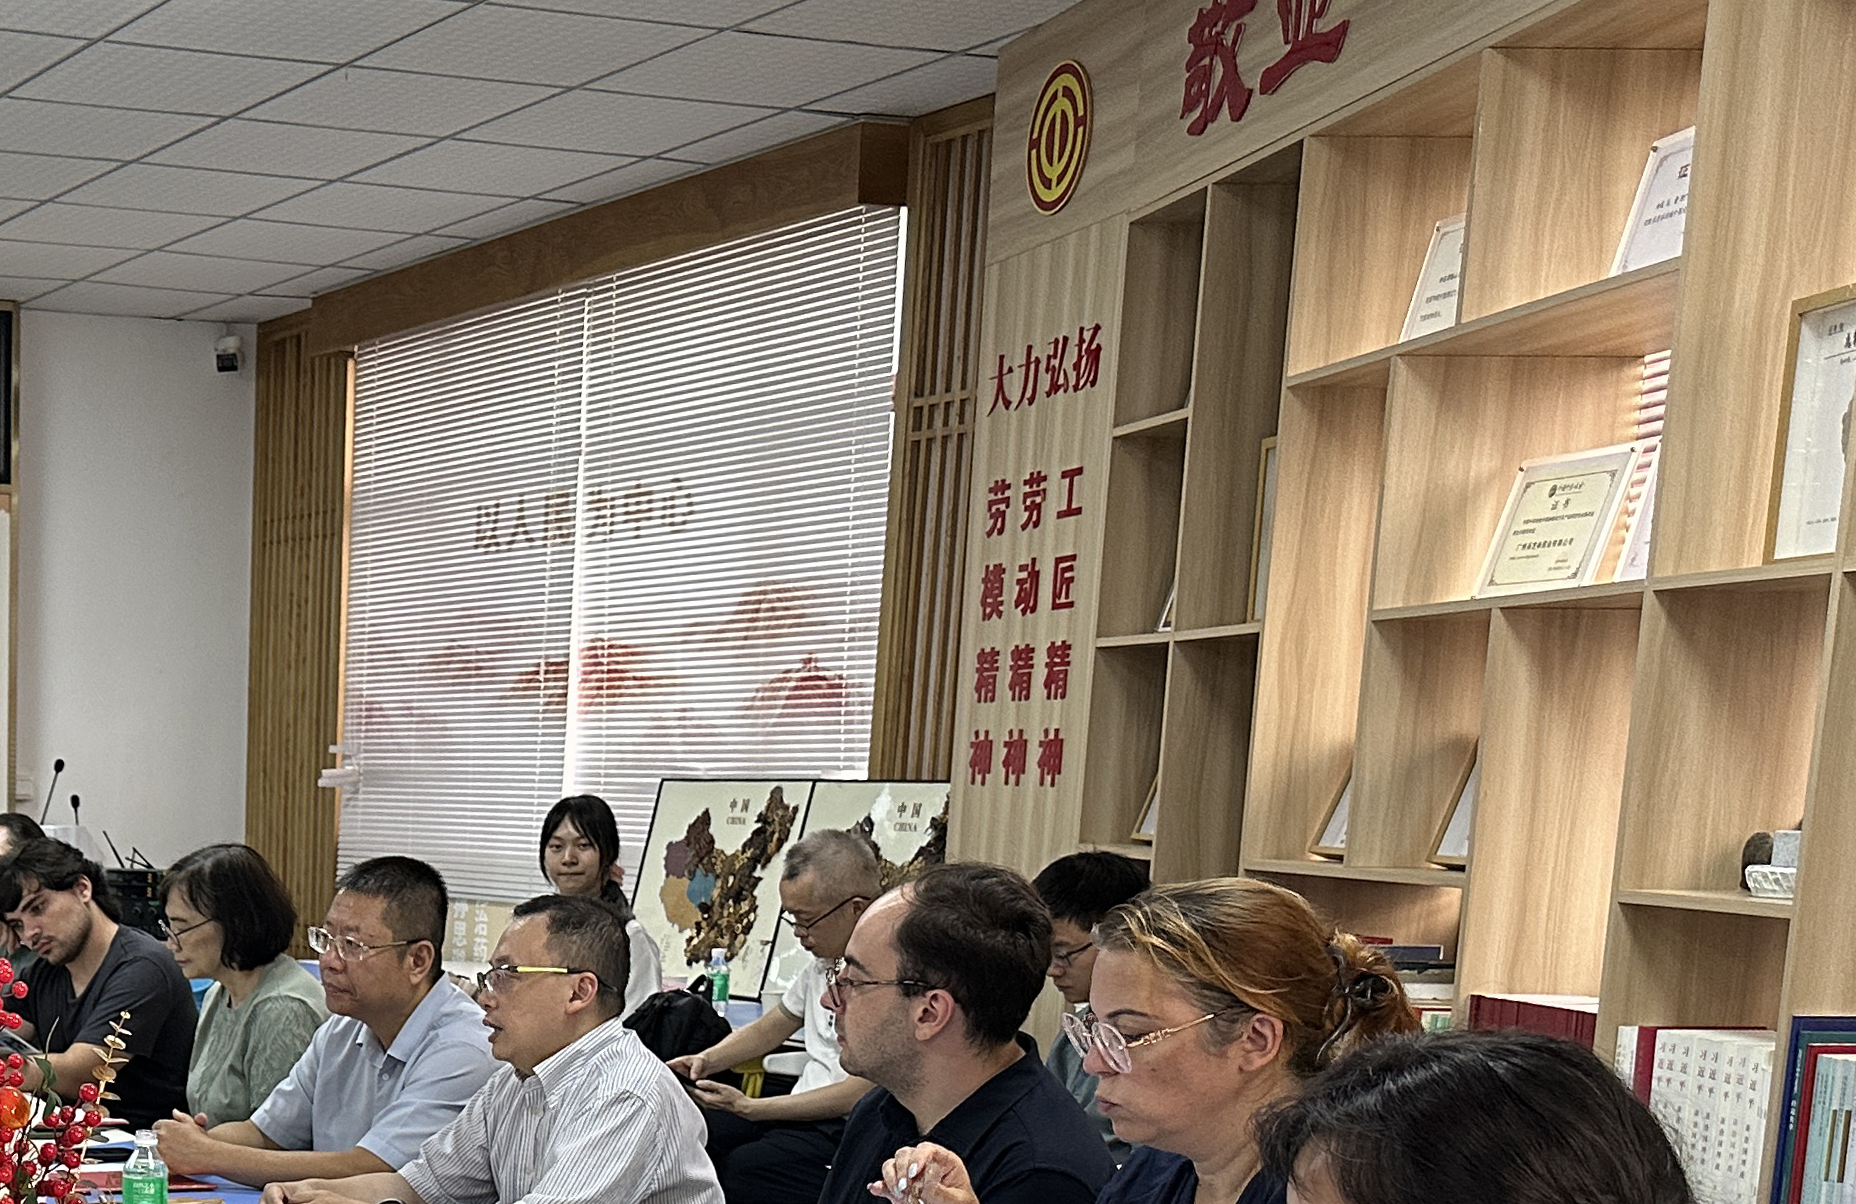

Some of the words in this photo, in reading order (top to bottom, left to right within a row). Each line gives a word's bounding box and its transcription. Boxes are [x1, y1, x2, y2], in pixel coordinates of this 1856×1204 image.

[987, 323, 1102, 418] 大力弘扬
[968, 478, 1012, 788] 劳模精神
[1001, 470, 1048, 789] 劳动精神
[1036, 465, 1084, 789] 工匠精神
[729, 797, 751, 813] 中国
[894, 821, 919, 833] CHINA
[896, 802, 923, 818] 中国
